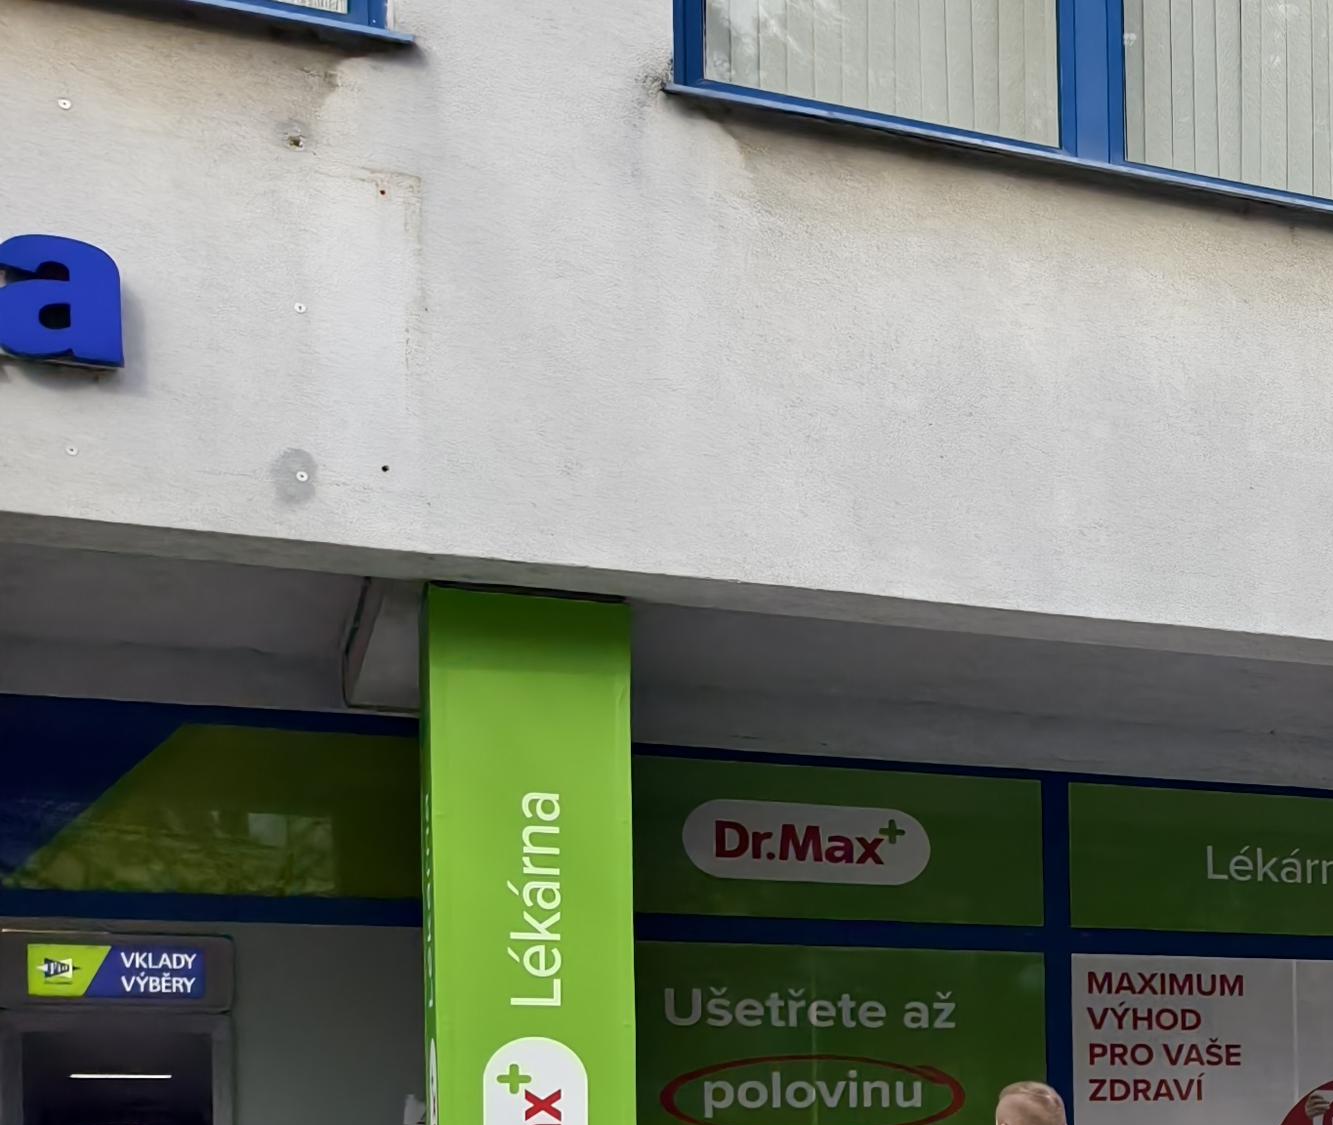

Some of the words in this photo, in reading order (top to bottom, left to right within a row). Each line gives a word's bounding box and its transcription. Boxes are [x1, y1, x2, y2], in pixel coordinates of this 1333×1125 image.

[506, 792, 562, 1006] Lékárna
[120, 952, 197, 969] VKLADY
[121, 971, 196, 993] VÝBĚRY
[1087, 971, 1245, 997] MAXIMUM
[664, 986, 887, 1029] Ušetřete
[904, 991, 956, 1030] až
[1087, 1002, 1202, 1031] VÝHOD
[1088, 1043, 1154, 1066] PRO
[1163, 1038, 1242, 1067] VAŠE
[703, 1070, 923, 1118] polovinu
[1088, 1074, 1204, 1102] ZDRAVÍ
